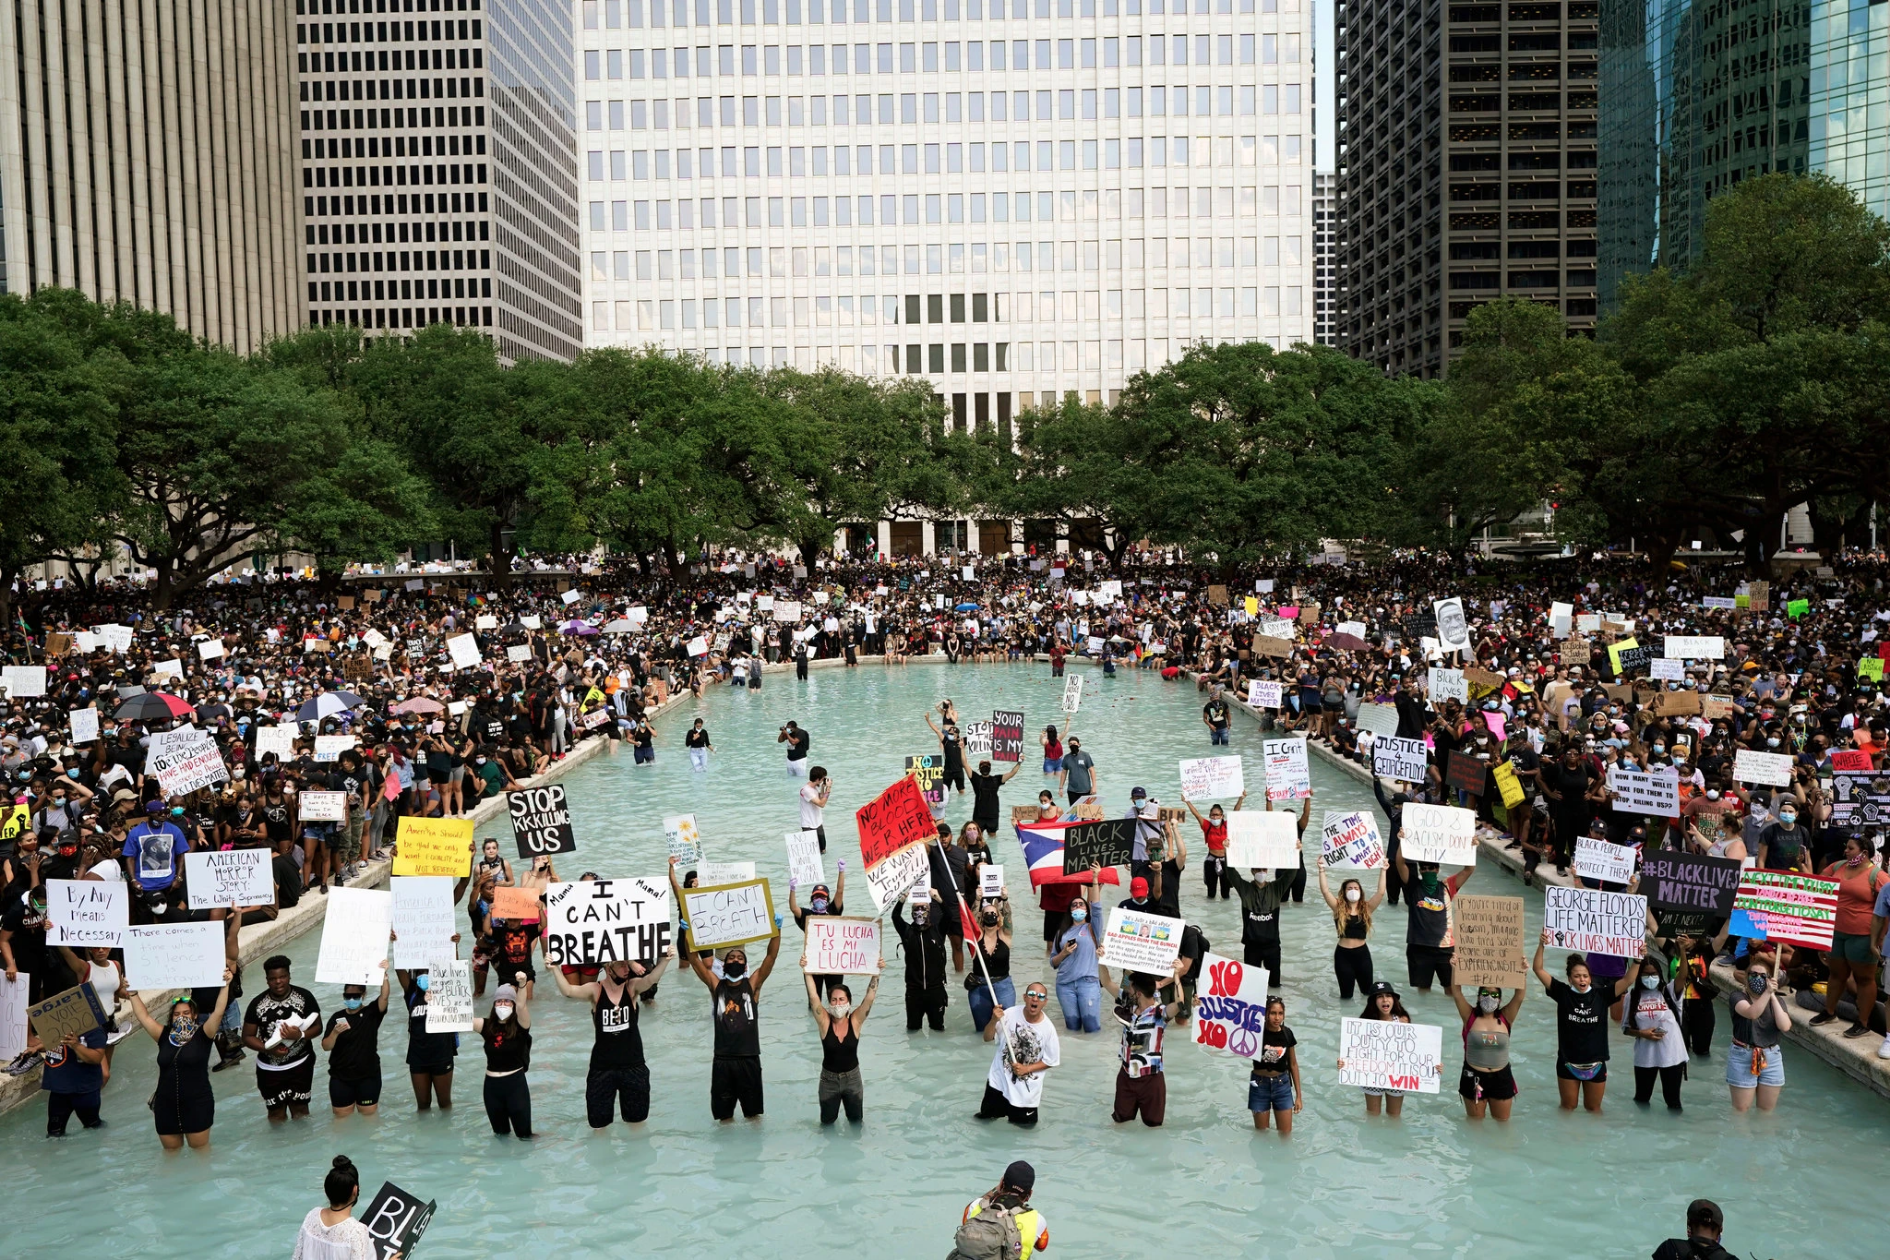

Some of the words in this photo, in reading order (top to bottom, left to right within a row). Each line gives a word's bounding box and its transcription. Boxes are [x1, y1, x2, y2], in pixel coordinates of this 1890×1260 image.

[1070, 676, 1078, 686] NO
[1256, 682, 1280, 691] BLACK
[1066, 695, 1074, 703] NO
[1250, 698, 1278, 706] MATTER
[994, 712, 1023, 727] YOUR
[262, 729, 288, 738] BLACK
[968, 722, 993, 736] STOP
[994, 728, 1020, 738] PAIN
[160, 732, 199, 746] LEGALIZE
[264, 740, 289, 748] LIVES
[994, 740, 1002, 750] IS
[1006, 740, 1023, 752] MY
[1375, 736, 1424, 755] JUSTICE
[318, 752, 336, 760] FREE
[994, 751, 1018, 762] PAIN
[1266, 744, 1278, 756] I
[159, 768, 178, 782] HAVE
[178, 761, 194, 774] HAD
[184, 778, 206, 793] LIVES
[204, 767, 228, 784] MATTER
[1652, 780, 1666, 788] WILL
[510, 786, 565, 817] STOP
[1615, 796, 1630, 804] STOP
[1633, 799, 1654, 807] KILLING
[1646, 789, 1662, 798] THEM
[860, 802, 878, 829] NO
[882, 780, 914, 811] MORE
[870, 797, 919, 837] BLOOD
[898, 810, 934, 837] HERE
[1159, 809, 1186, 822] BLM
[1412, 808, 1443, 828] GOD
[1451, 812, 1462, 831] &
[1324, 824, 1340, 838] THE
[1342, 812, 1362, 828] TIME
[528, 828, 561, 852] US
[794, 833, 806, 842] NO
[1069, 822, 1126, 848] BLACK
[1324, 842, 1331, 852] IS
[1332, 822, 1368, 848] ALWAYS
[1404, 828, 1444, 846] RACISM
[788, 841, 819, 857] FREEDOM
[1080, 842, 1116, 856] LIVES
[1324, 846, 1349, 866] RIGHT
[1352, 838, 1366, 850] TO
[1368, 830, 1378, 842] DO
[1350, 846, 1372, 865] WHAT
[1424, 847, 1446, 862] MIX
[1578, 838, 1598, 850] BLACK
[1600, 842, 1622, 856] PEOPLE
[206, 852, 260, 868] AMERICAN
[868, 866, 886, 883] WE
[889, 845, 920, 870] WANT
[1066, 850, 1131, 874] MATTER
[1363, 848, 1384, 869] RIGHT
[215, 866, 256, 881] HORROR
[1576, 860, 1606, 874] PROTECT
[1609, 866, 1630, 880] THEM
[1642, 859, 1740, 890] #BLACKLIVES
[550, 883, 574, 907] Mama
[592, 880, 614, 898] I
[636, 879, 667, 900] Mama!
[1742, 872, 1775, 886] NEXT
[1777, 874, 1800, 890] TIME
[1819, 881, 1836, 896] SAY
[66, 886, 86, 908] By
[90, 887, 114, 910] Any
[192, 894, 208, 905] The
[691, 894, 707, 916] I
[714, 885, 759, 912] CAN'T
[1458, 898, 1466, 910] IF
[1546, 886, 1597, 910] GEORGE
[1599, 892, 1646, 918] FLOYD'S
[1658, 880, 1720, 910] MATTER
[70, 908, 106, 922] means
[566, 899, 645, 924] CAN'T
[1249, 912, 1273, 922] Reebok
[1462, 910, 1492, 924] hearing
[1496, 912, 1519, 924] about
[1660, 914, 1672, 924] AM
[1674, 914, 1680, 924] I
[1680, 914, 1704, 926] NEXT?
[1809, 906, 1831, 920] SAY
[691, 907, 766, 939] BREATH
[814, 924, 836, 938] TU
[842, 926, 874, 939] LUCHA
[1546, 908, 1574, 931] LIFE
[1578, 911, 1646, 940] MATTERED
[60, 925, 122, 945] Necessary
[128, 928, 160, 938] There
[1118, 934, 1136, 942] APPLES
[1460, 934, 1474, 944] how
[1478, 936, 1495, 947] tired
[140, 942, 165, 952] time
[172, 938, 200, 950] when
[550, 922, 670, 966] BREATHE
[822, 938, 834, 950] ES
[843, 940, 857, 950] MI
[1580, 933, 1604, 952] LIVES
[1606, 937, 1644, 958] MATTER
[140, 953, 206, 967] Silence
[818, 952, 868, 970] LUCHA
[141, 970, 206, 987] Betrayal
[1208, 960, 1243, 997] NO
[1471, 973, 1505, 985] #BLM
[32, 990, 82, 1018] Large
[428, 995, 451, 1007] LIVES
[49, 1004, 83, 1024] VOTE
[602, 1006, 628, 1026] BETO
[1568, 1014, 1598, 1024] BREATHE
[48, 1012, 94, 1043] 2020
[1197, 1019, 1228, 1050] NO
[1346, 1021, 1362, 1035] IT
[1366, 1022, 1382, 1038] IS
[1386, 1024, 1418, 1040] OUR
[1350, 1034, 1390, 1050] DUTY
[1394, 1038, 1416, 1053] TO
[1346, 1046, 1378, 1061] FIGHT
[1384, 1050, 1404, 1063] FOR
[1408, 1052, 1434, 1066] OUR
[1340, 1069, 1369, 1086] DUTY
[1374, 1072, 1386, 1086] TO
[1388, 1074, 1419, 1090] WIN
